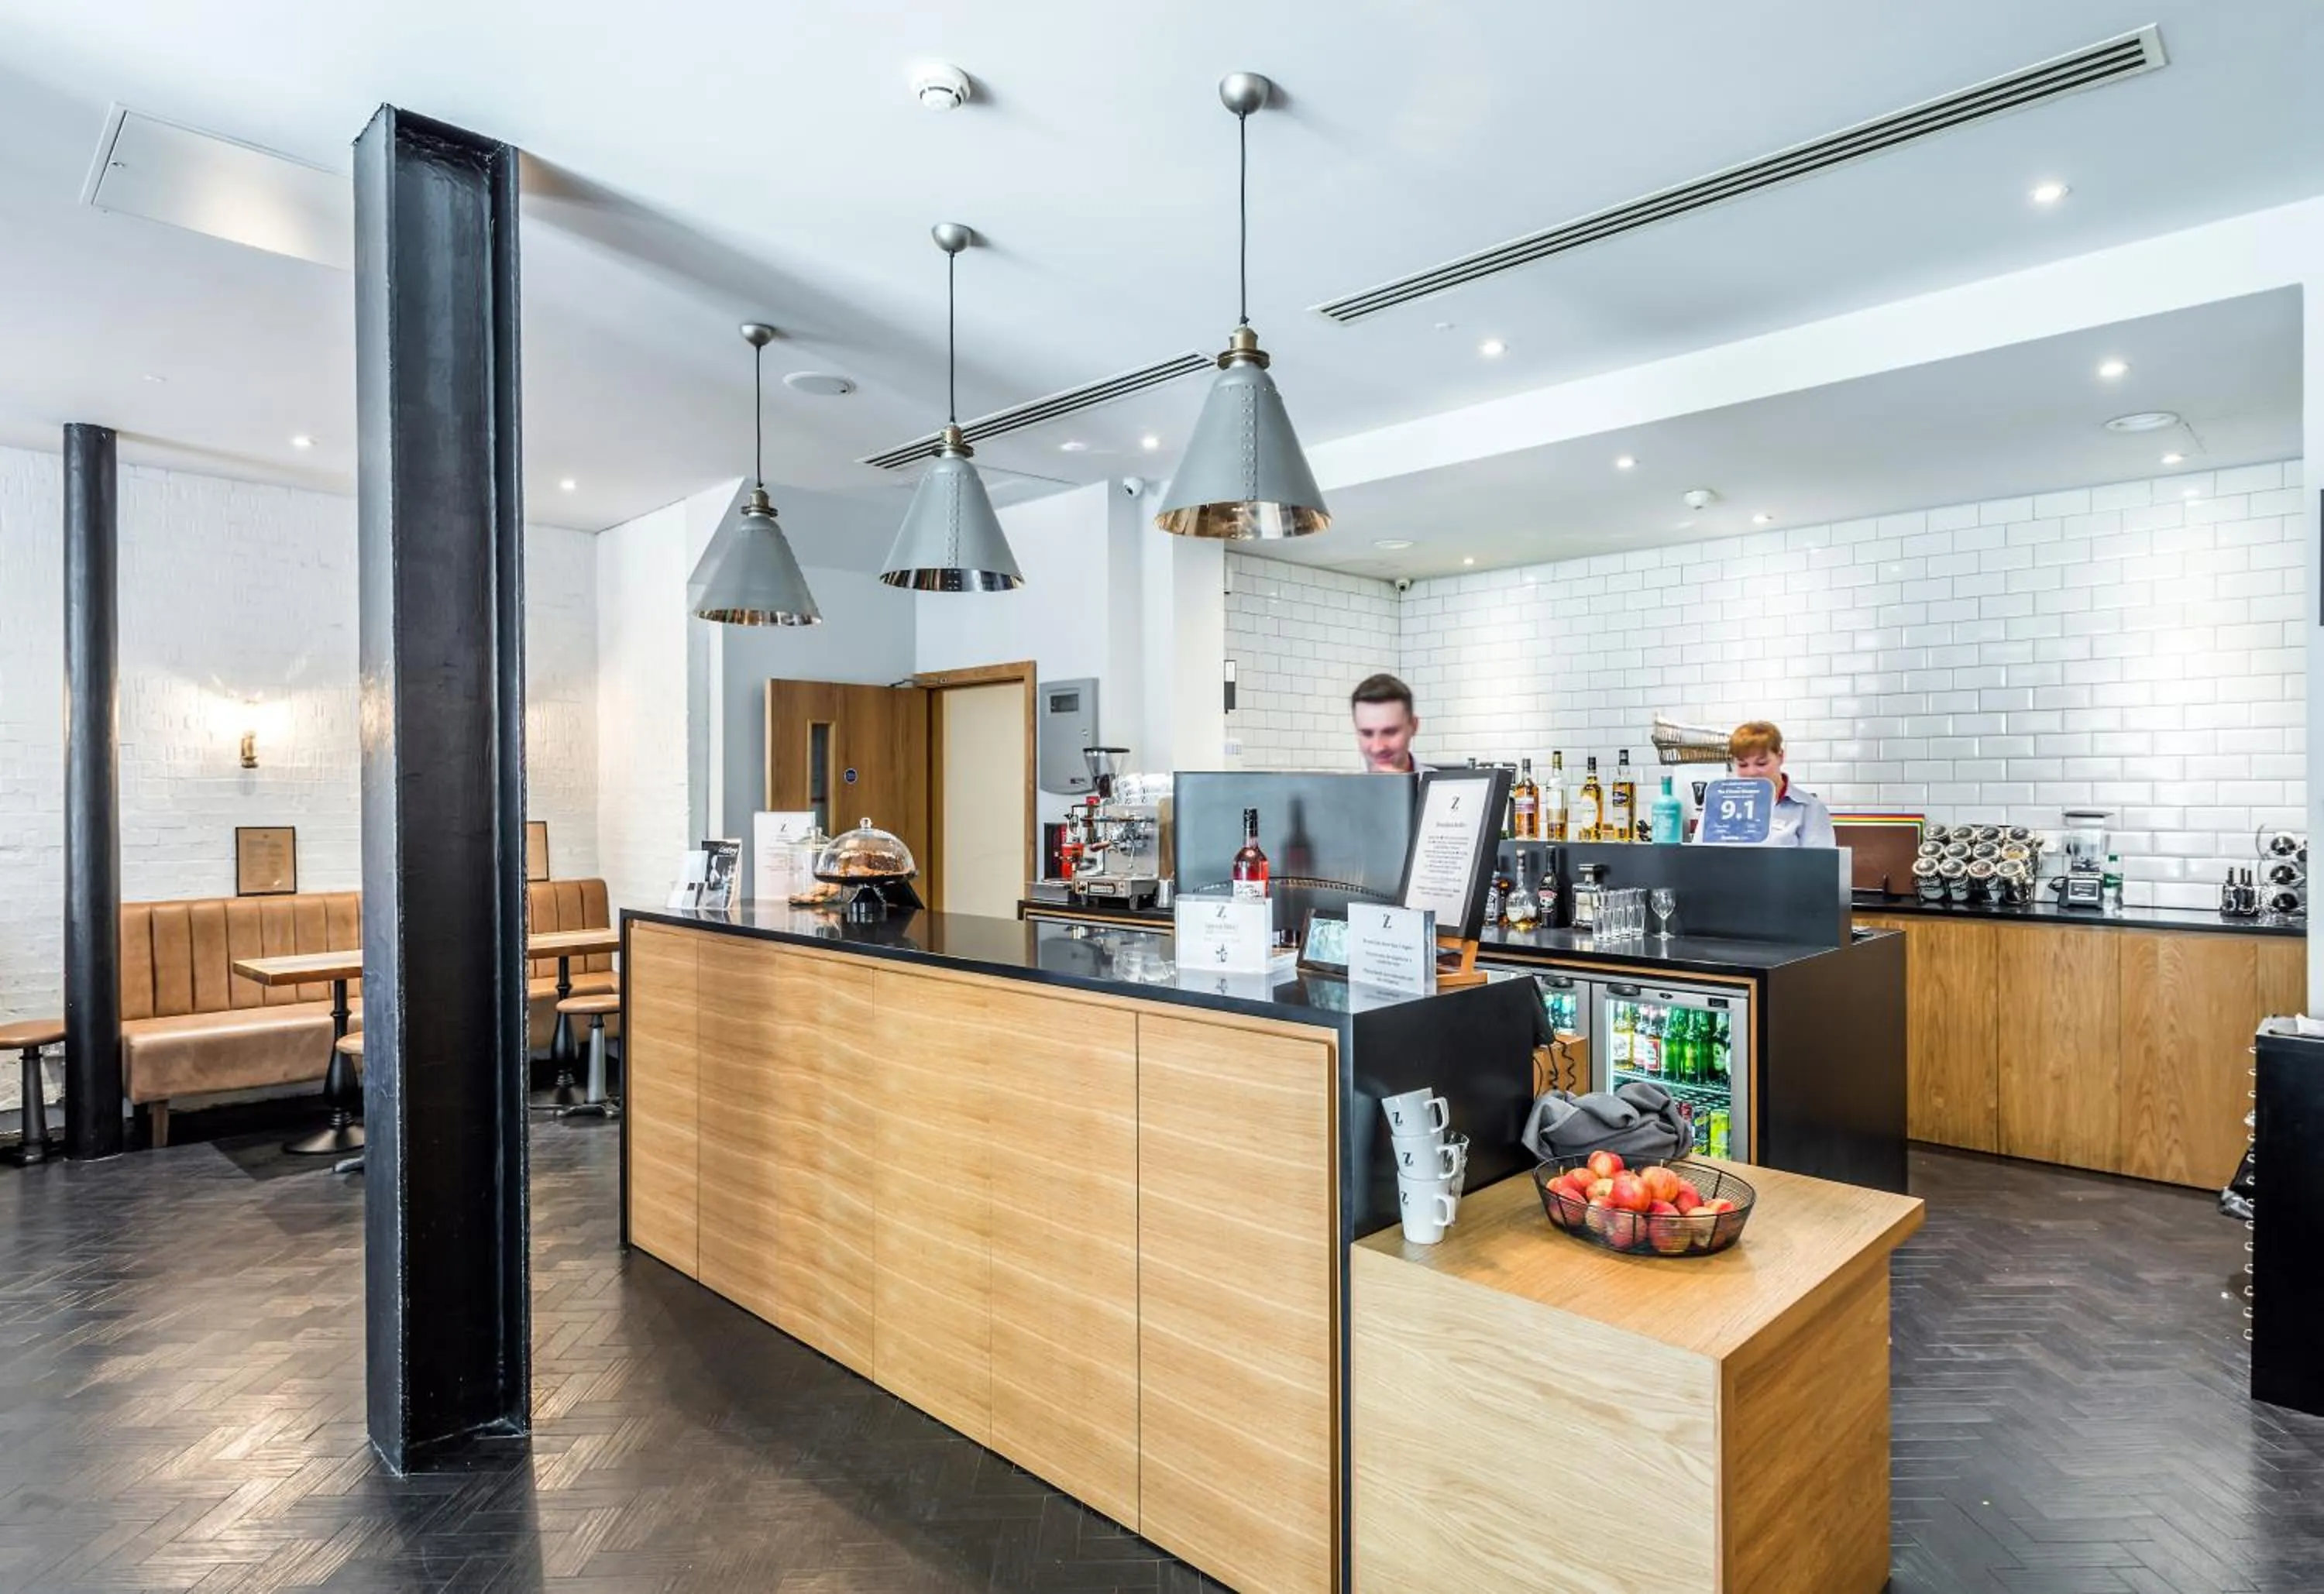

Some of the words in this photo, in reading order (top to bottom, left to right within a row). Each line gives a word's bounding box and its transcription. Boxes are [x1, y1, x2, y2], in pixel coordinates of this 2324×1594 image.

[1450, 795, 1460, 809] Z
[1721, 800, 1755, 819] 9.1
[1215, 904, 1227, 918] Z
[1382, 913, 1392, 929] Z
[1392, 1111, 1404, 1127] Z
[1403, 1152, 1414, 1166] Z
[1401, 1191, 1410, 1205] Z
